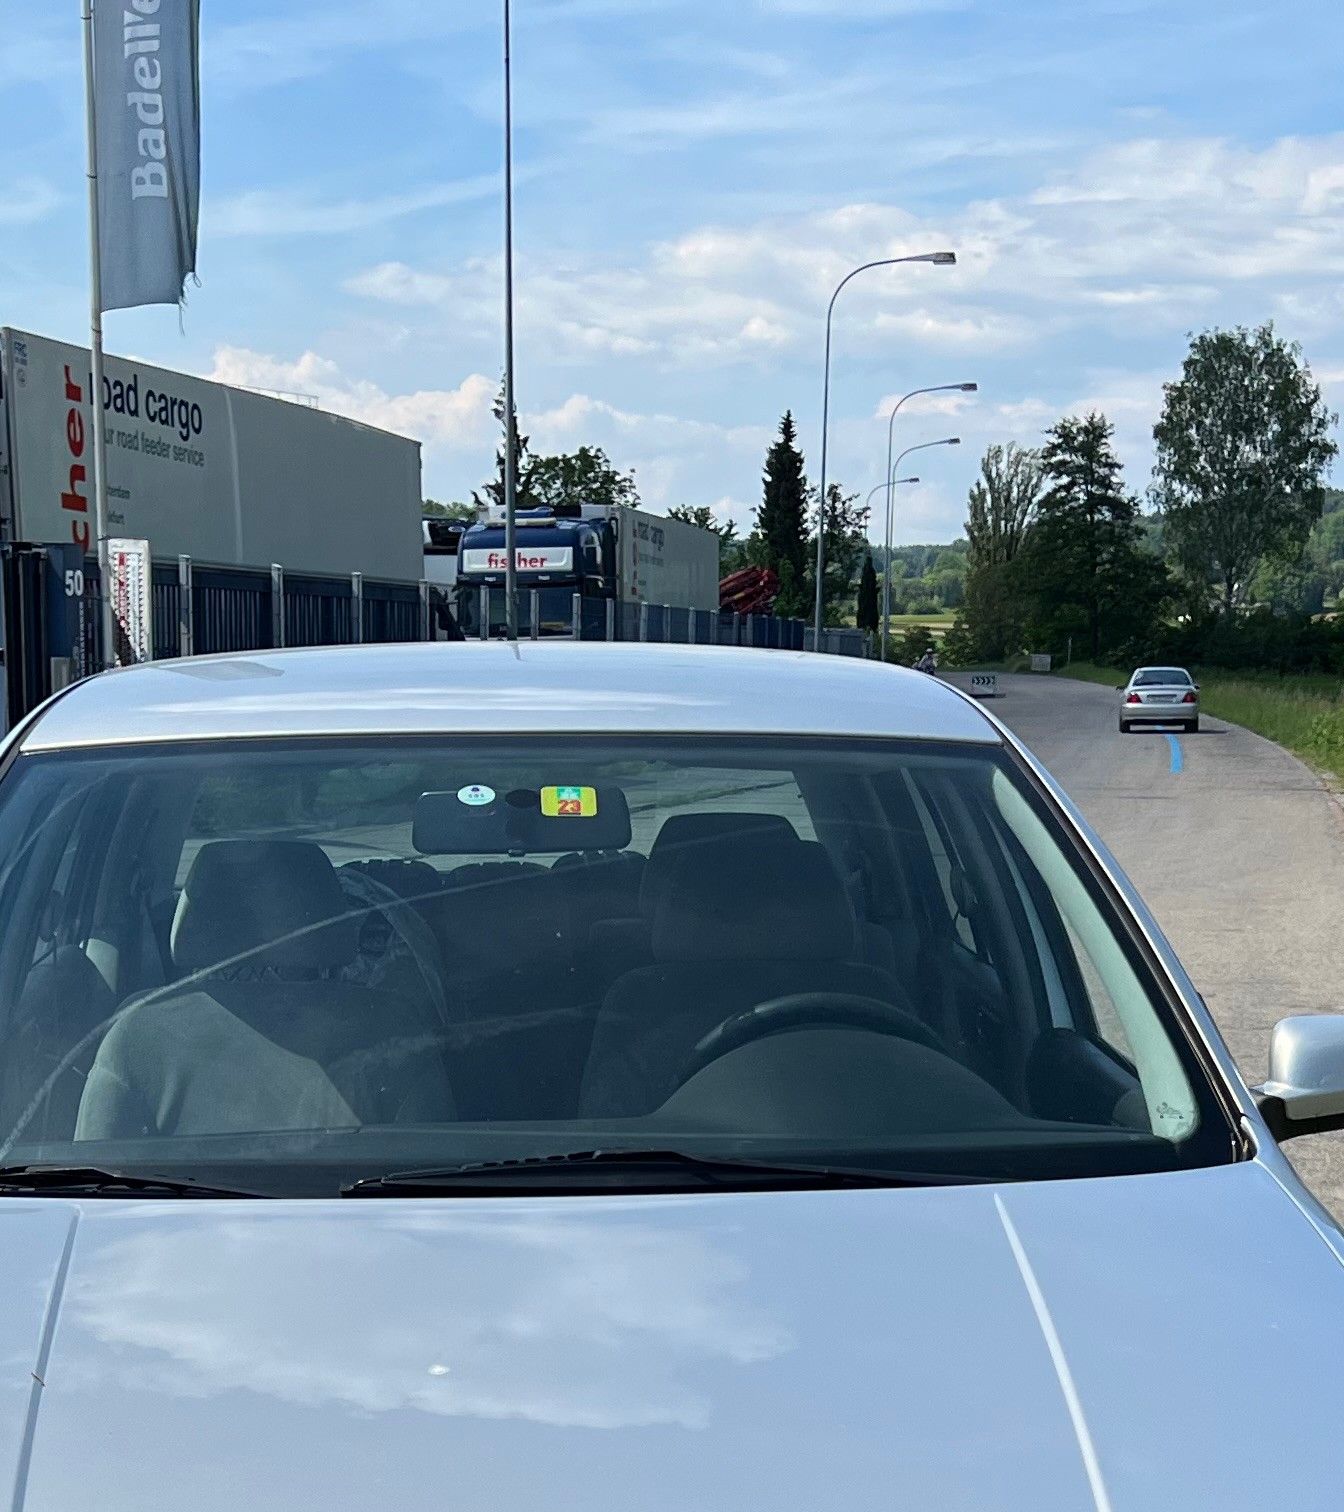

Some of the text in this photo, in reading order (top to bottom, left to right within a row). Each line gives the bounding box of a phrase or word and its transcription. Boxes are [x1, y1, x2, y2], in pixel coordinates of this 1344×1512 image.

[146, 388, 203, 442] cargo
[117, 429, 139, 452] road
[172, 444, 205, 467] service
[487, 552, 548, 569] fisher
[64, 569, 85, 597] 50
[557, 800, 582, 814] 23
